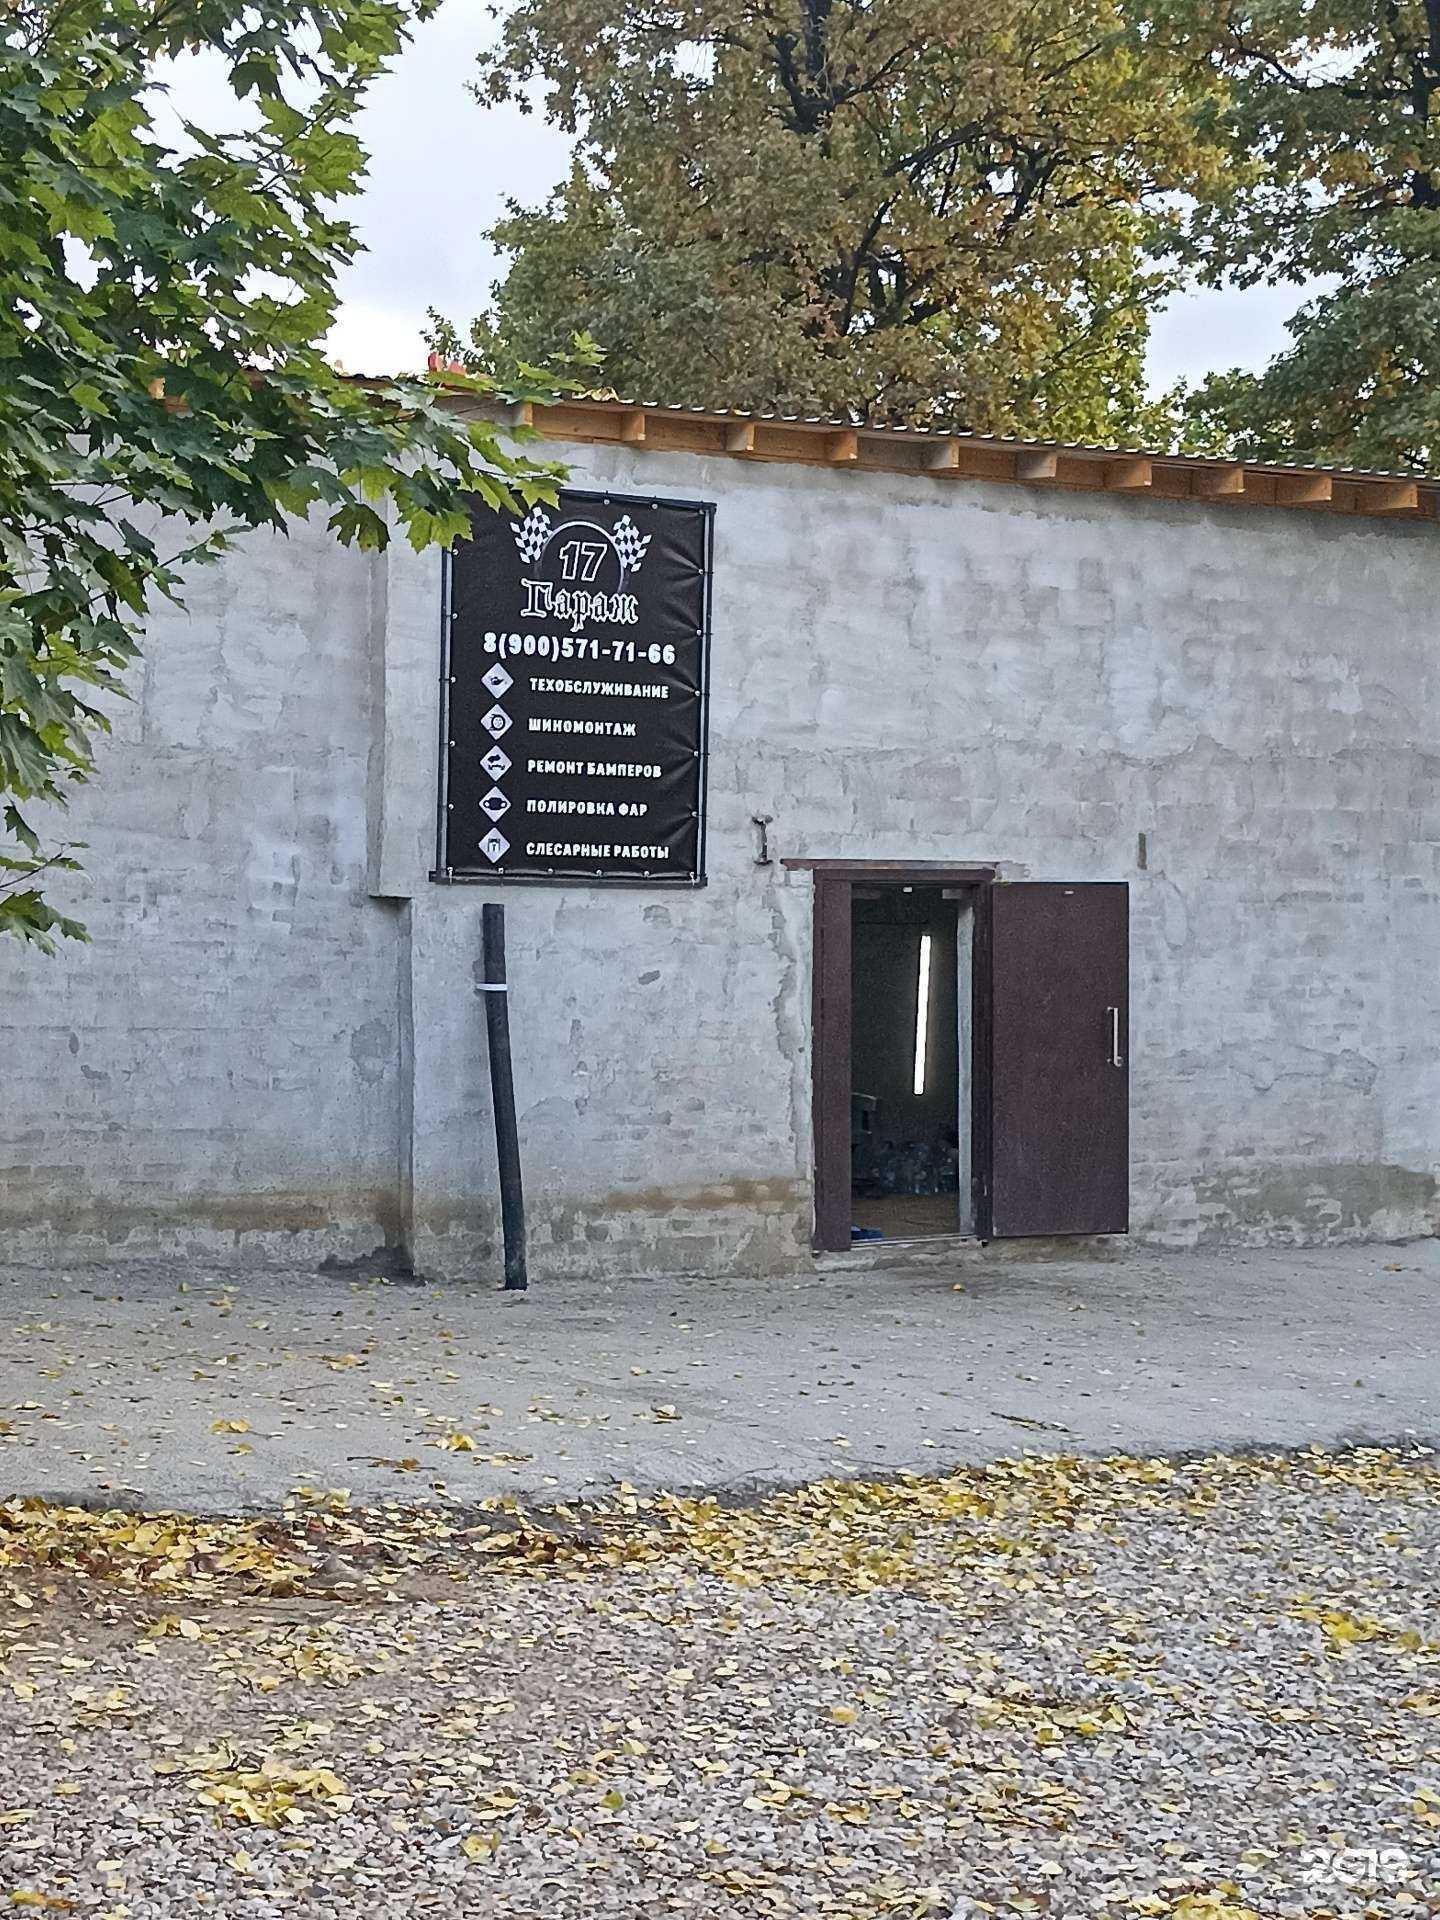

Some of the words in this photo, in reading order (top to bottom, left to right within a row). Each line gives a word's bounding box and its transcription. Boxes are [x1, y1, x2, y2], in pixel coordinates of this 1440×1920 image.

[559, 540, 608, 582] 17
[520, 577, 639, 632] Гараж
[483, 632, 676, 665] 8(900)571-71-66
[529, 677, 670, 699] ТЕХОБСЛУЖИВАНИЕ
[528, 718, 636, 737] ШИНОМОНТАЖ
[527, 759, 584, 775] РЕМОНТ
[586, 760, 662, 778] БАМПЕРОВ
[526, 799, 615, 816] ПОЛИРОВКА
[618, 803, 648, 817] ФАР
[526, 842, 611, 858] СЛЕСАРНЫЕ
[613, 845, 669, 859] РАБОТЫ
